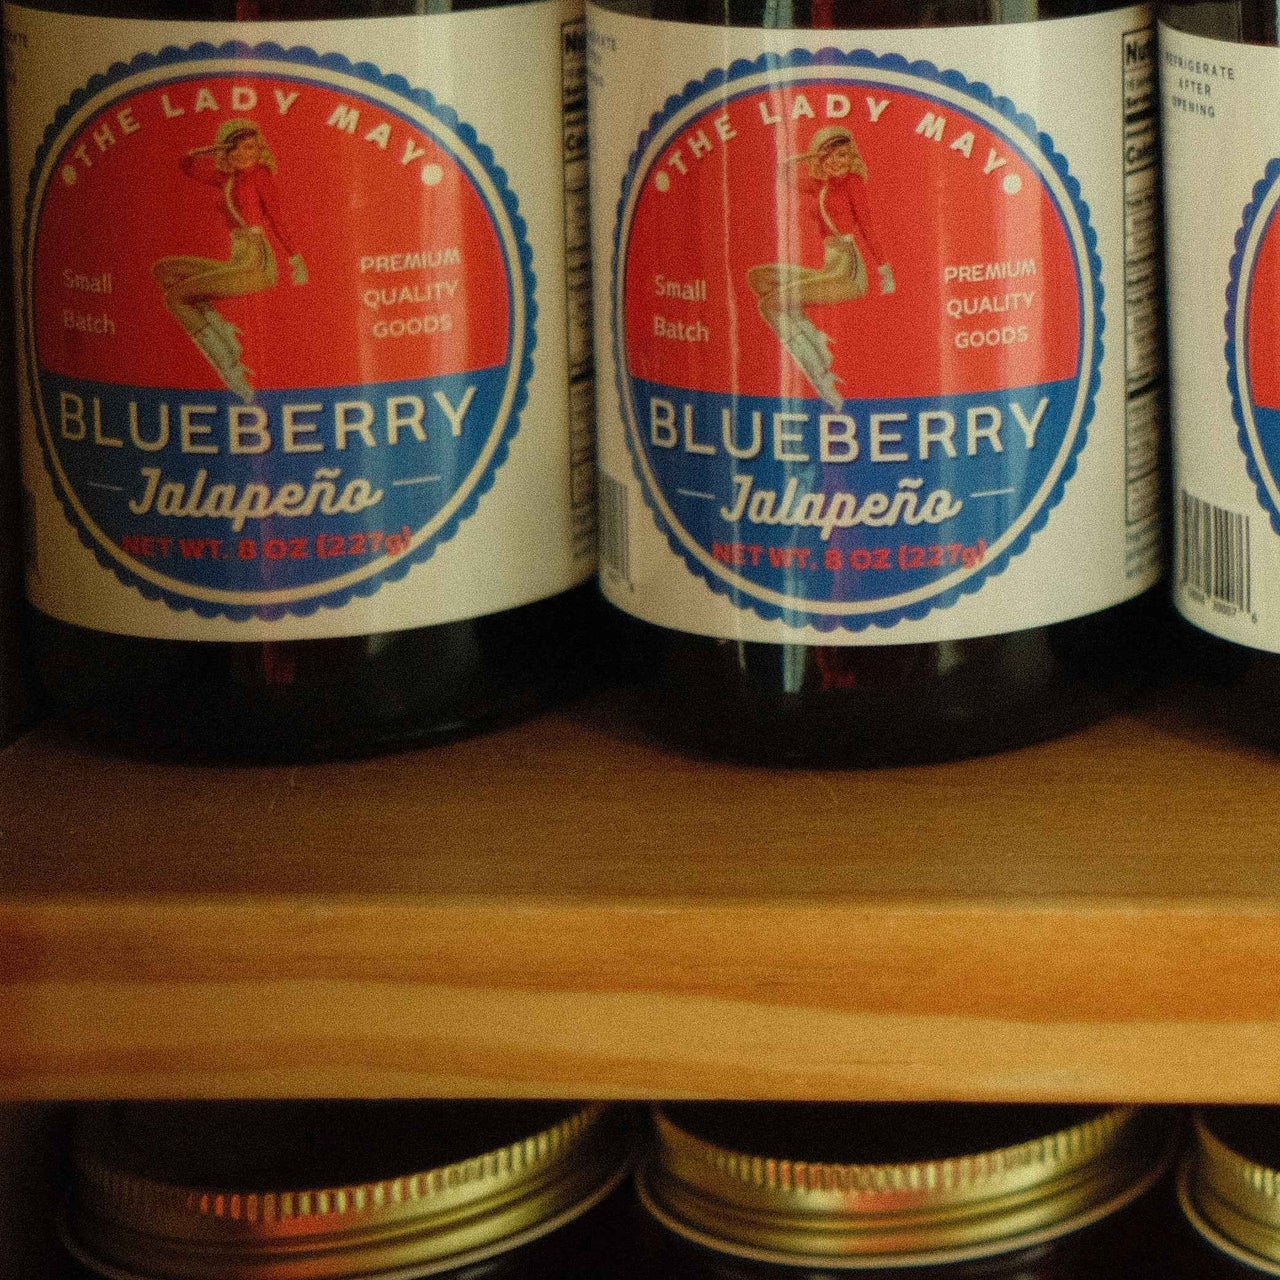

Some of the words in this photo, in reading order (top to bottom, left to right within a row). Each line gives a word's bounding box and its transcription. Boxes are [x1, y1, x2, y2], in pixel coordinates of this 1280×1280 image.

[75, 110, 142, 170] THE
[160, 85, 300, 117] LADY
[326, 103, 427, 169] MAY
[668, 114, 738, 176] THE
[758, 93, 890, 126] LADY
[914, 114, 1008, 177] MAY
[359, 246, 462, 275] PREMIUM
[944, 257, 1037, 285] PREMIUM
[62, 267, 113, 297] Small
[362, 279, 460, 310] QUALITY
[654, 272, 707, 302] Small
[945, 290, 1036, 320] QUALITY
[62, 310, 117, 336] Batch
[372, 313, 453, 341] GOODS
[652, 315, 710, 344] Batch
[953, 323, 1030, 350] GOODS
[58, 385, 478, 457] BLUEBERRY
[649, 395, 1050, 464] BLUEBERRY
[127, 467, 384, 533] Jalapeño
[720, 475, 965, 541] Jalapeño
[121, 534, 171, 558] NET
[180, 536, 229, 561] WT.
[238, 537, 254, 561] 8
[267, 536, 309, 561] OZ
[315, 524, 414, 561] (227g)
[710, 540, 764, 567] NET
[768, 544, 820, 569] WT.
[824, 546, 843, 570] 8
[848, 545, 892, 570] OZ
[898, 537, 988, 571] (227g)
